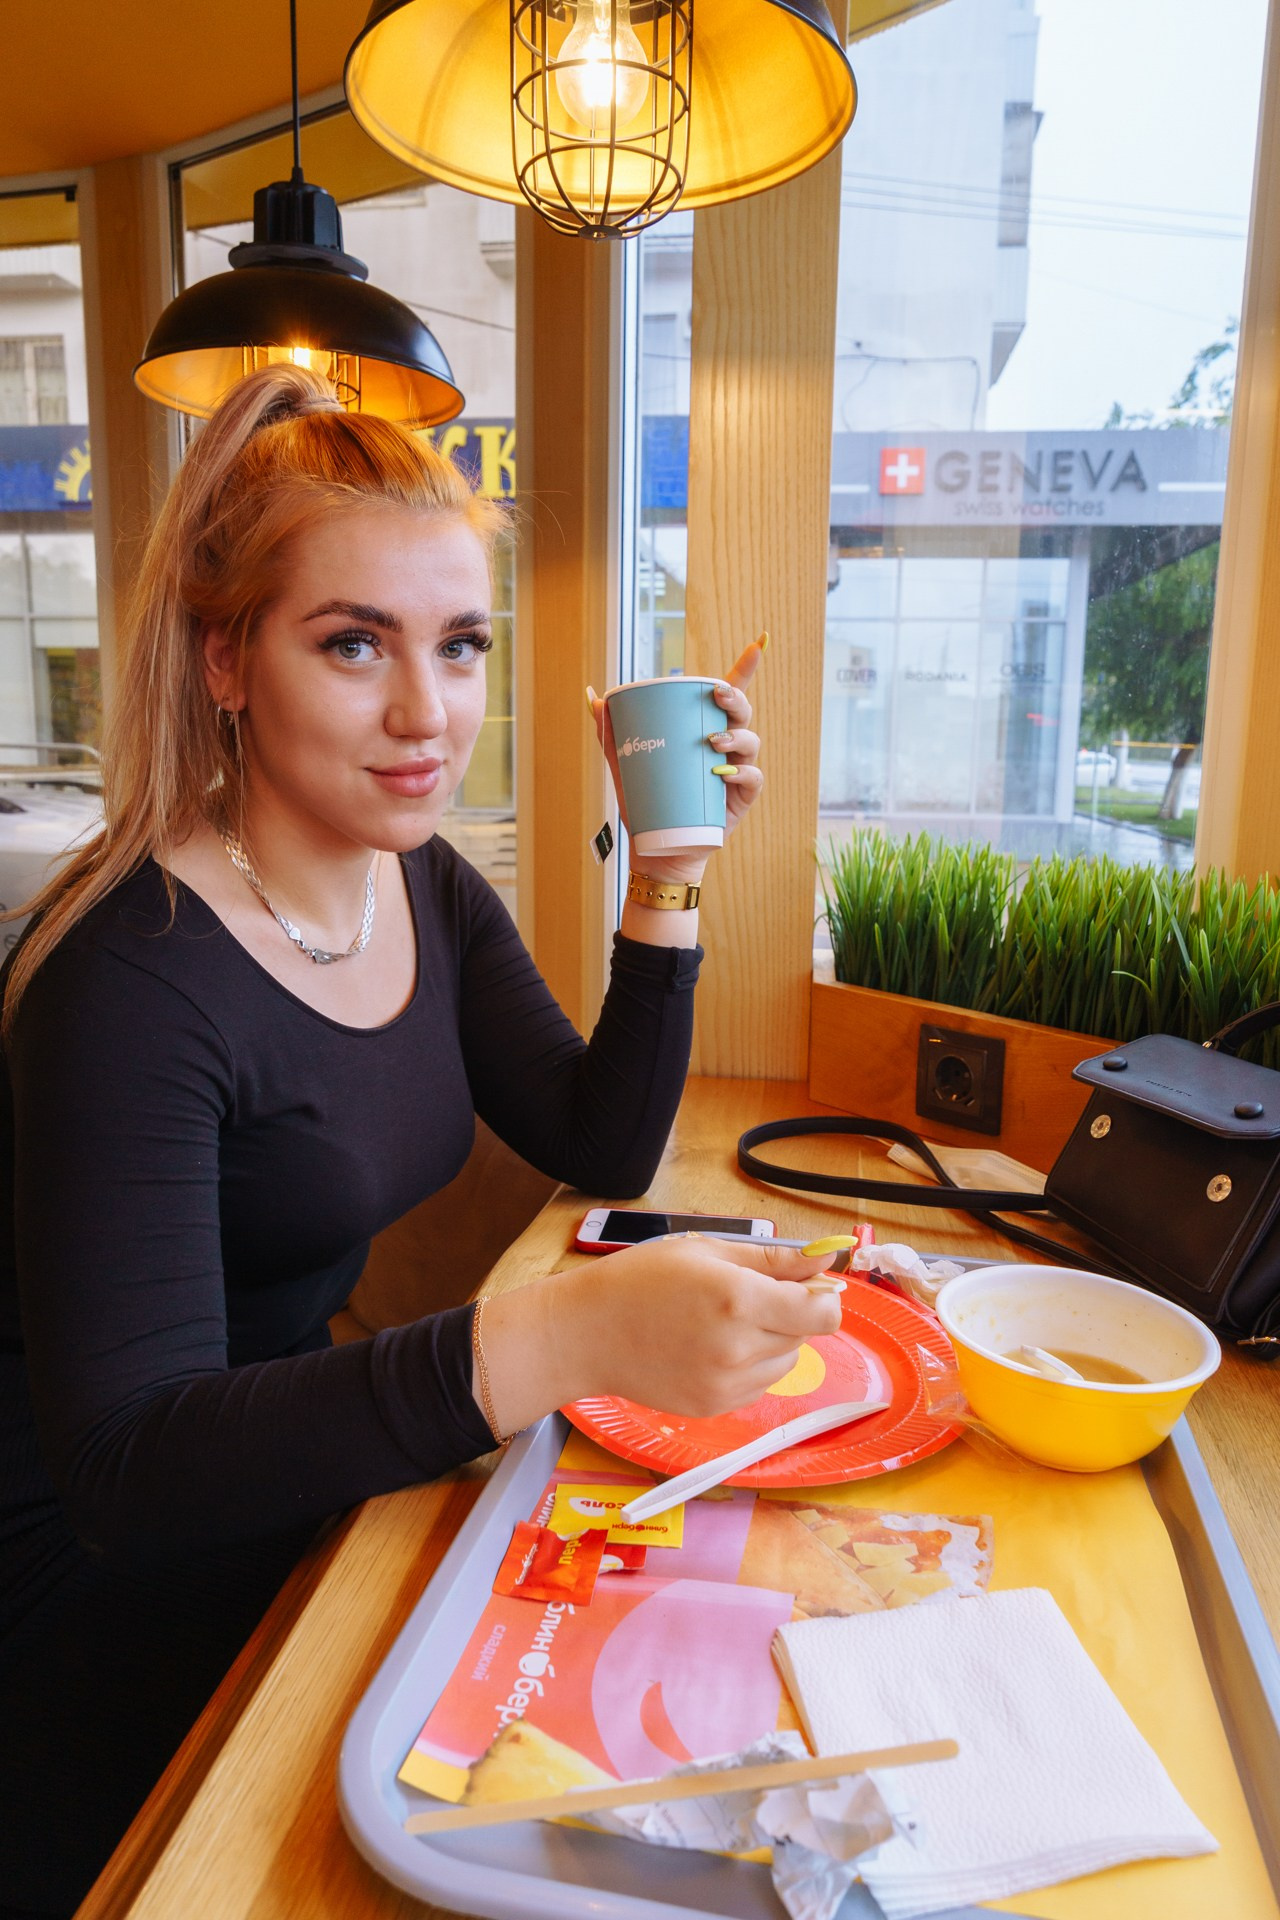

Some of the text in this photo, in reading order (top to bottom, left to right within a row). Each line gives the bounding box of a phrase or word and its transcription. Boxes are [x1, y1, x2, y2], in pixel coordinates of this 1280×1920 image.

[934, 447, 1149, 494] GENEVA
[953, 496, 1106, 517] swiss watches
[470, 1624, 507, 1681] сладкий
